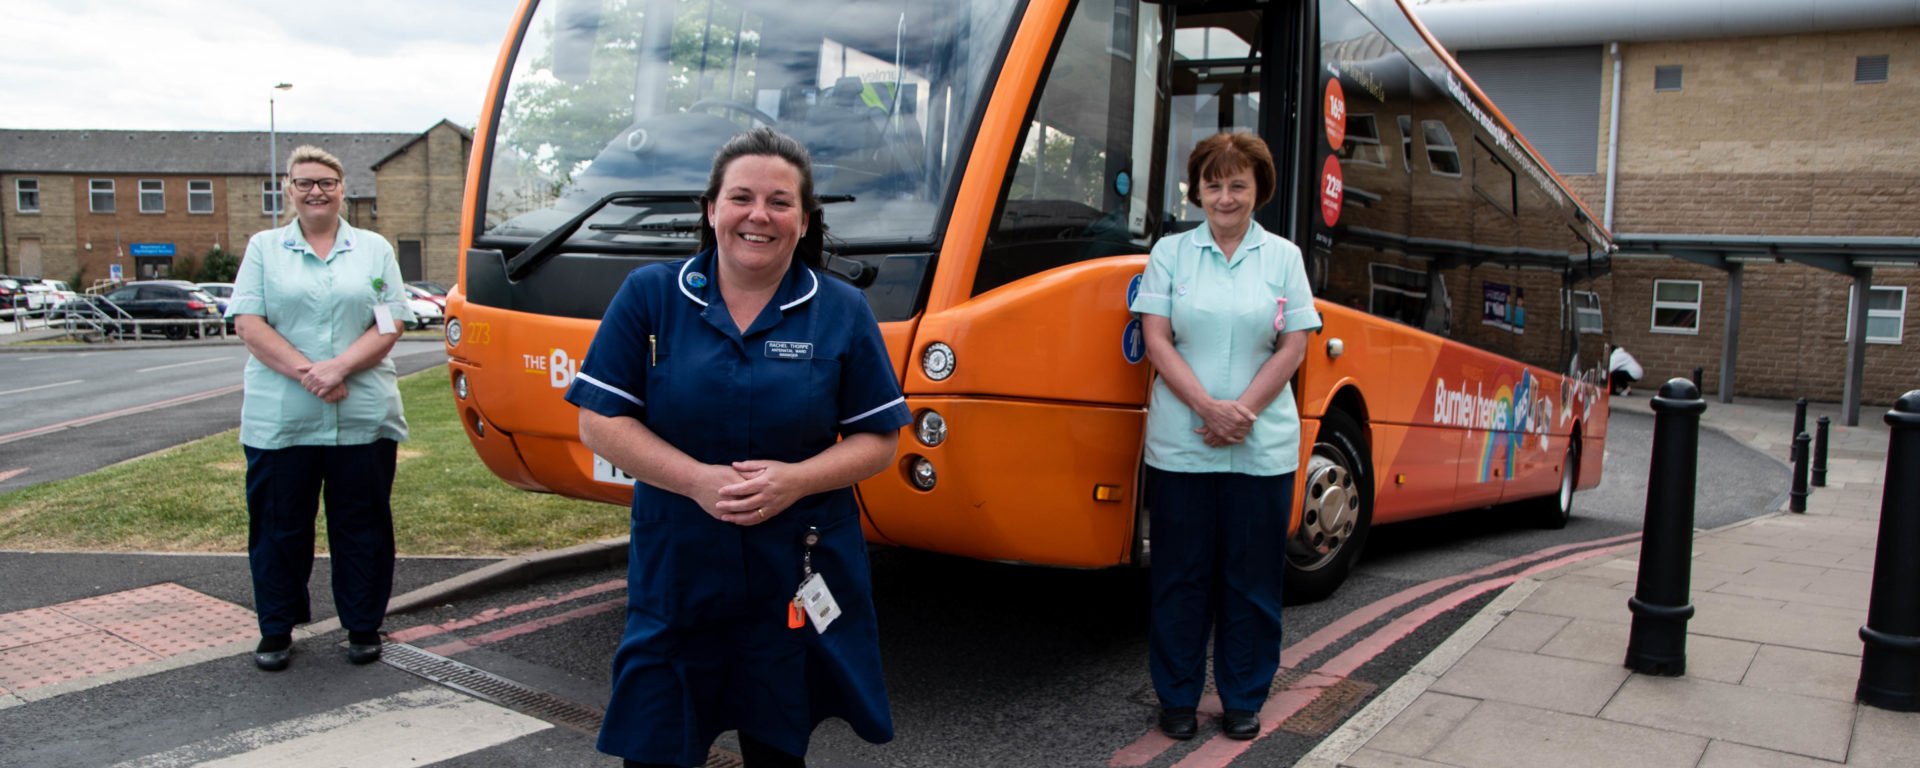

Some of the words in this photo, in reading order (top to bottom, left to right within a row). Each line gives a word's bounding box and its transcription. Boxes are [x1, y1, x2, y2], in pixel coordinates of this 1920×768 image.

[467, 321, 491, 345] 273
[523, 354, 547, 370] THE
[1433, 377, 1476, 439] Burnley
[1475, 381, 1508, 430] heroes
